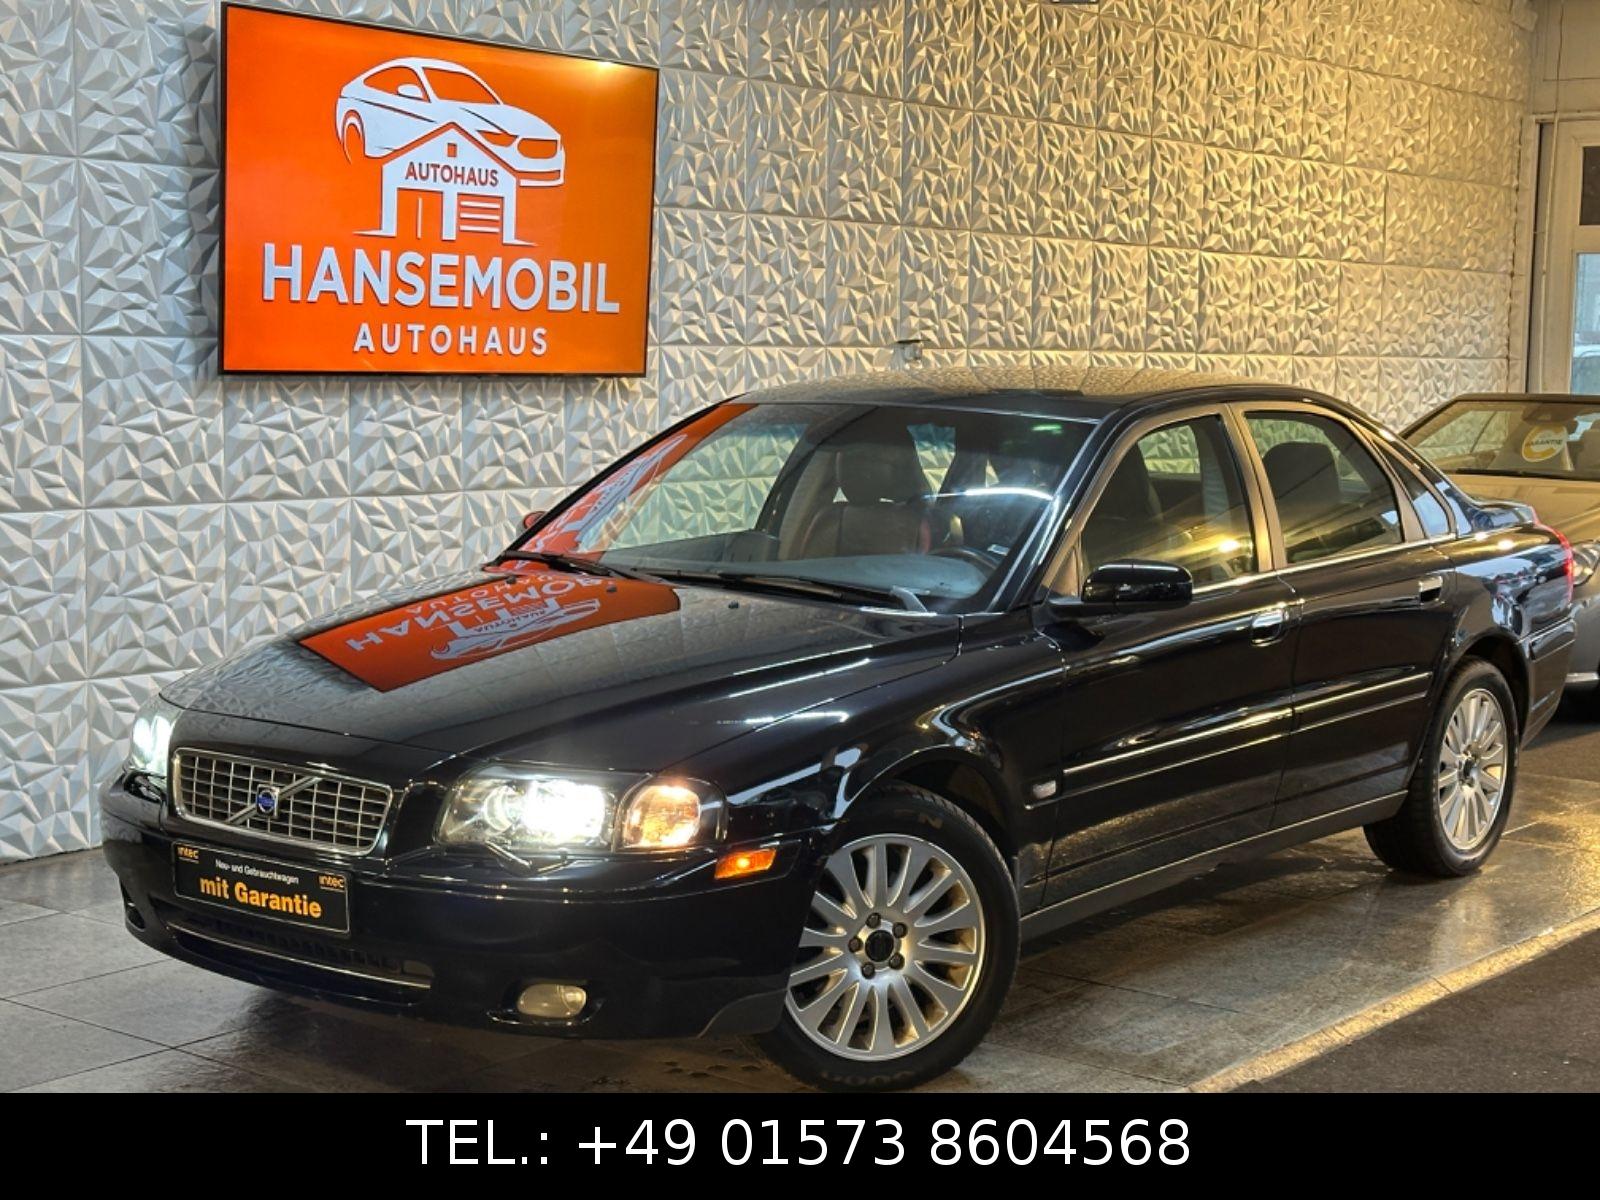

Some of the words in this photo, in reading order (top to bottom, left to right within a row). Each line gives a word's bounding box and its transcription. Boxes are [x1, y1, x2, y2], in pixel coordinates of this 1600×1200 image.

[404, 161, 499, 187] AUTOHAUS
[262, 242, 620, 314] HANSEMOBIL
[353, 323, 548, 356] AUTOHAUS
[231, 864, 243, 875] und
[244, 864, 300, 886] Gebrauchtwagen
[199, 875, 230, 900] mit
[234, 881, 323, 919] Garantie
